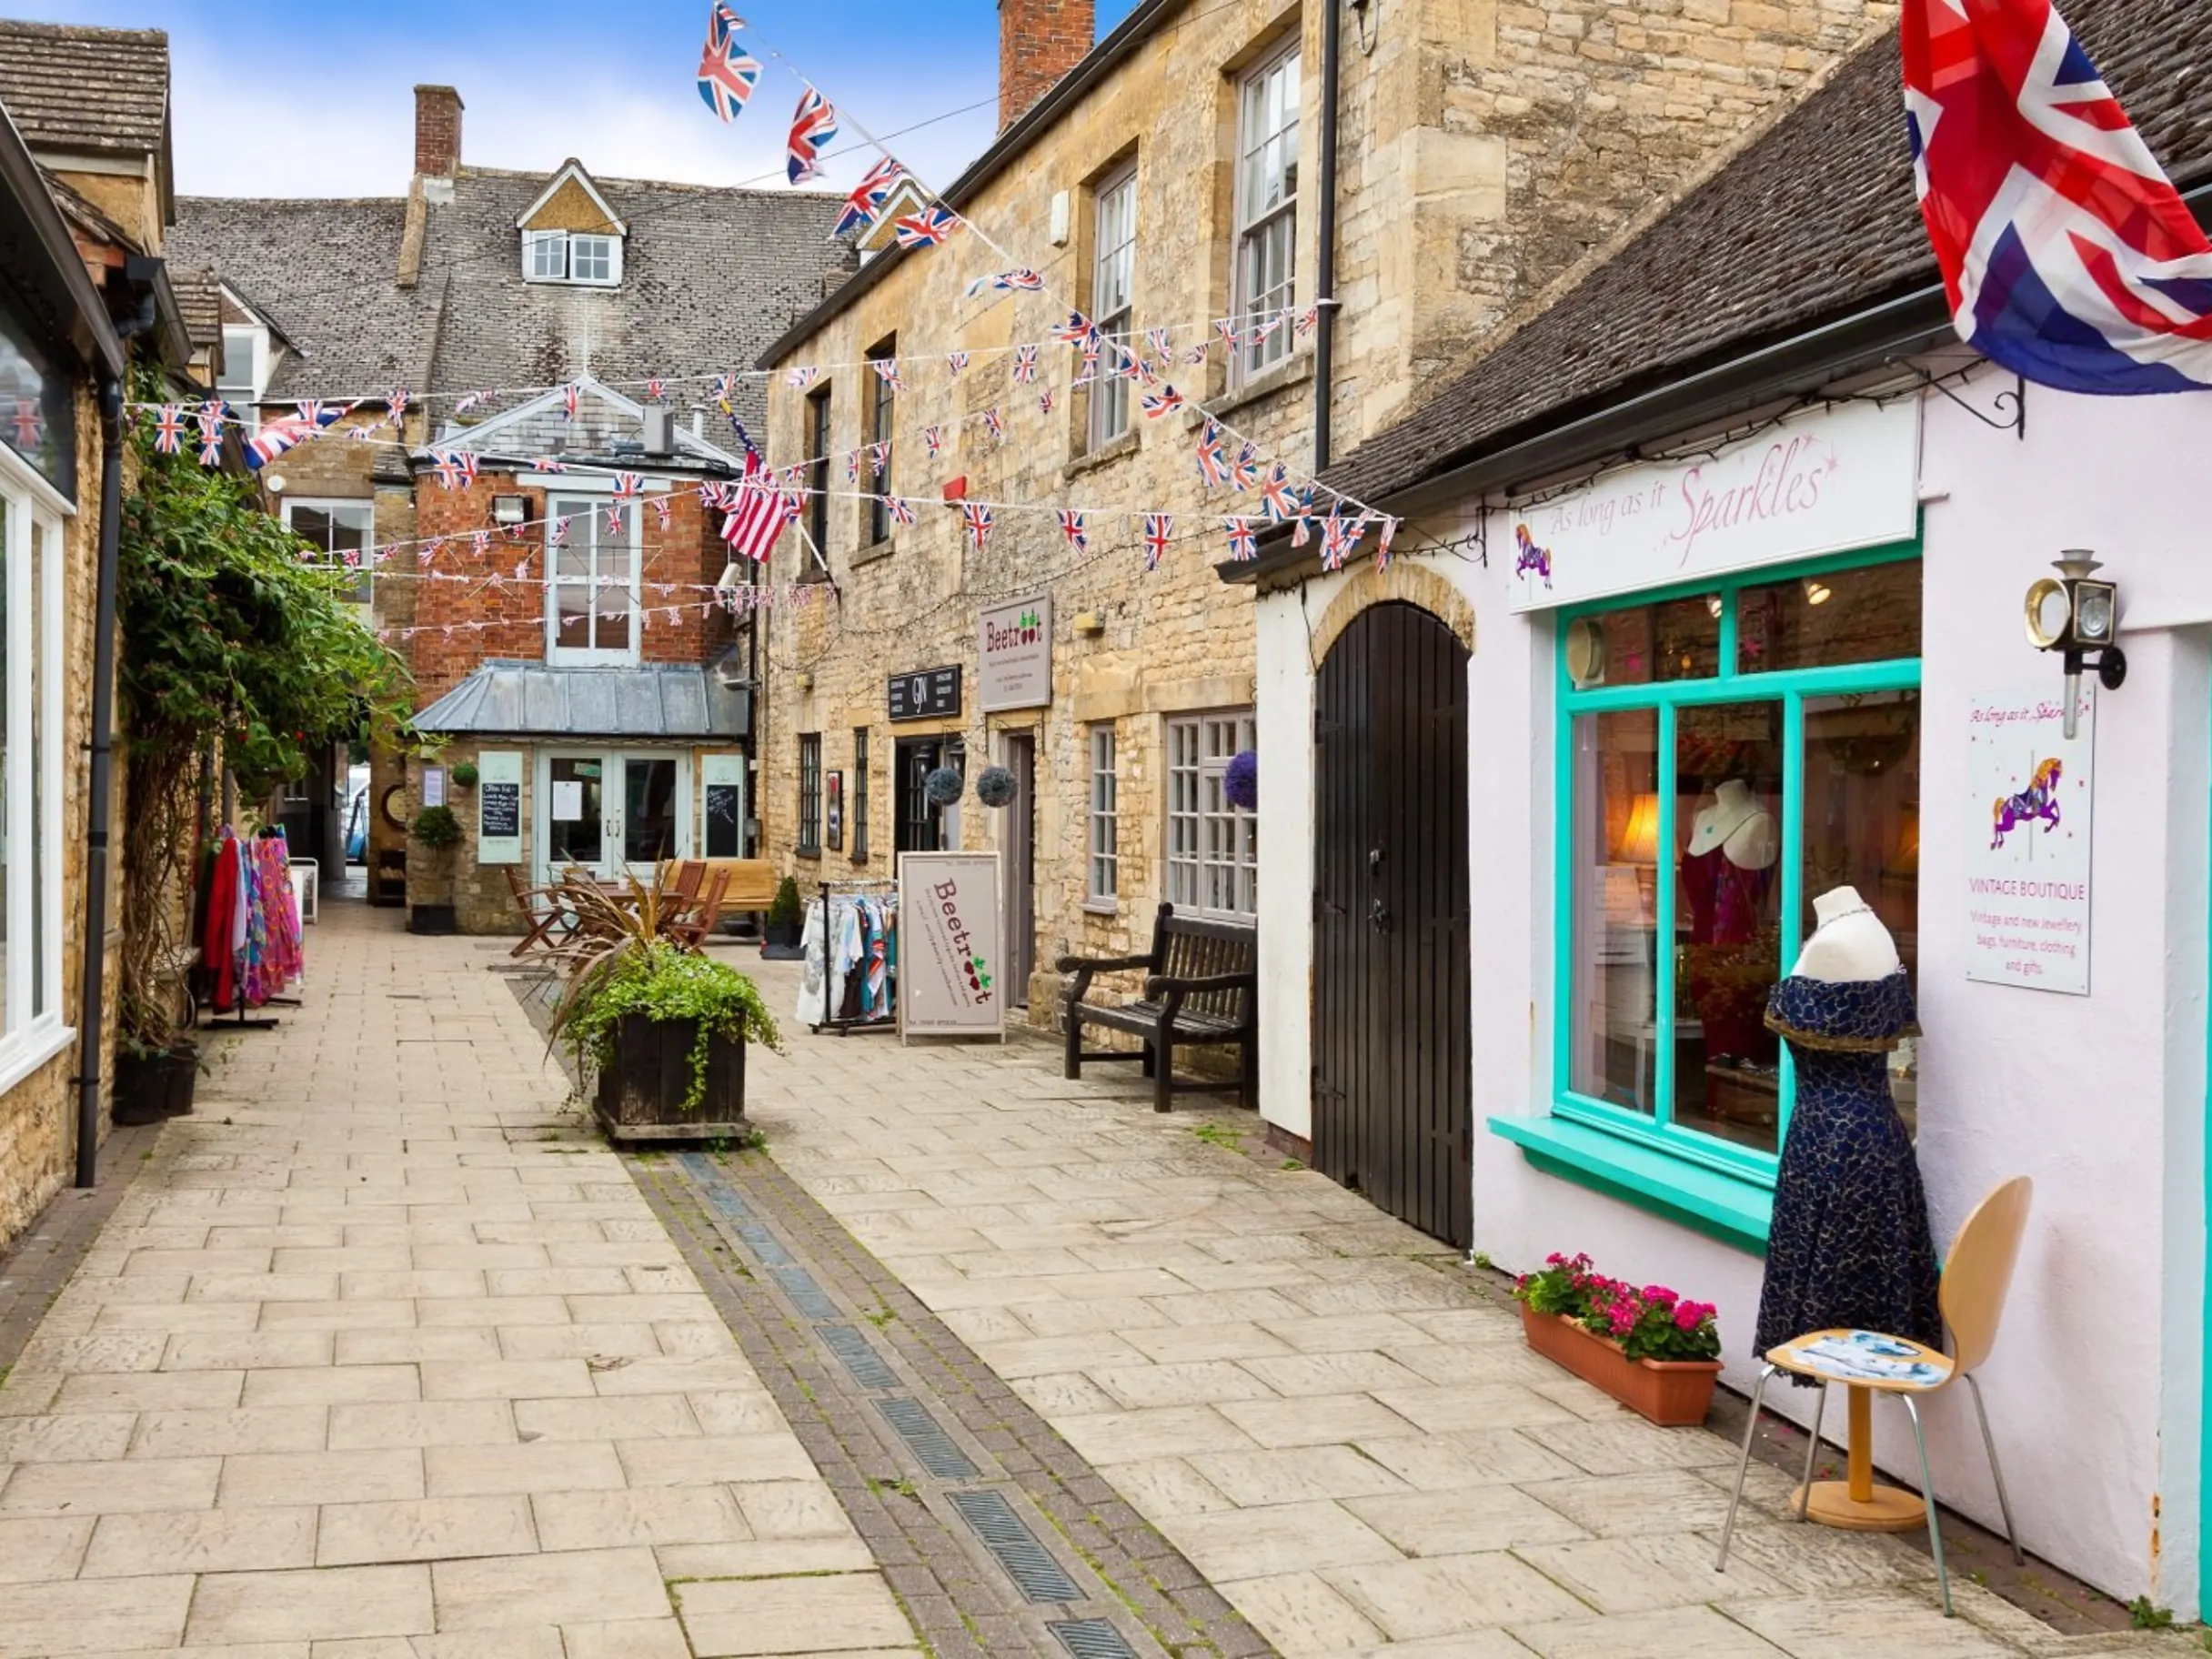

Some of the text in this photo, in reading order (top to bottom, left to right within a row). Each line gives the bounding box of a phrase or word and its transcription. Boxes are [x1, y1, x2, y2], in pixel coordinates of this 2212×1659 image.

[1550, 506, 1573, 535] As
[1578, 491, 1615, 537] long
[1621, 491, 1643, 517] as
[1650, 480, 1667, 509] it
[986, 611, 1043, 653] Beetroot
[1970, 709, 1984, 722] As
[1984, 706, 2006, 728] long
[2006, 710, 2019, 721] as
[1968, 878, 2085, 900] VINTAGE BOUTIQUE
[1969, 910, 2001, 928] Vintage
[2004, 915, 2019, 927] and
[2022, 918, 2039, 928] new
[933, 878, 992, 1005] Beetroot
[2039, 940, 2076, 960] clothing
[2005, 960, 2021, 972] and
